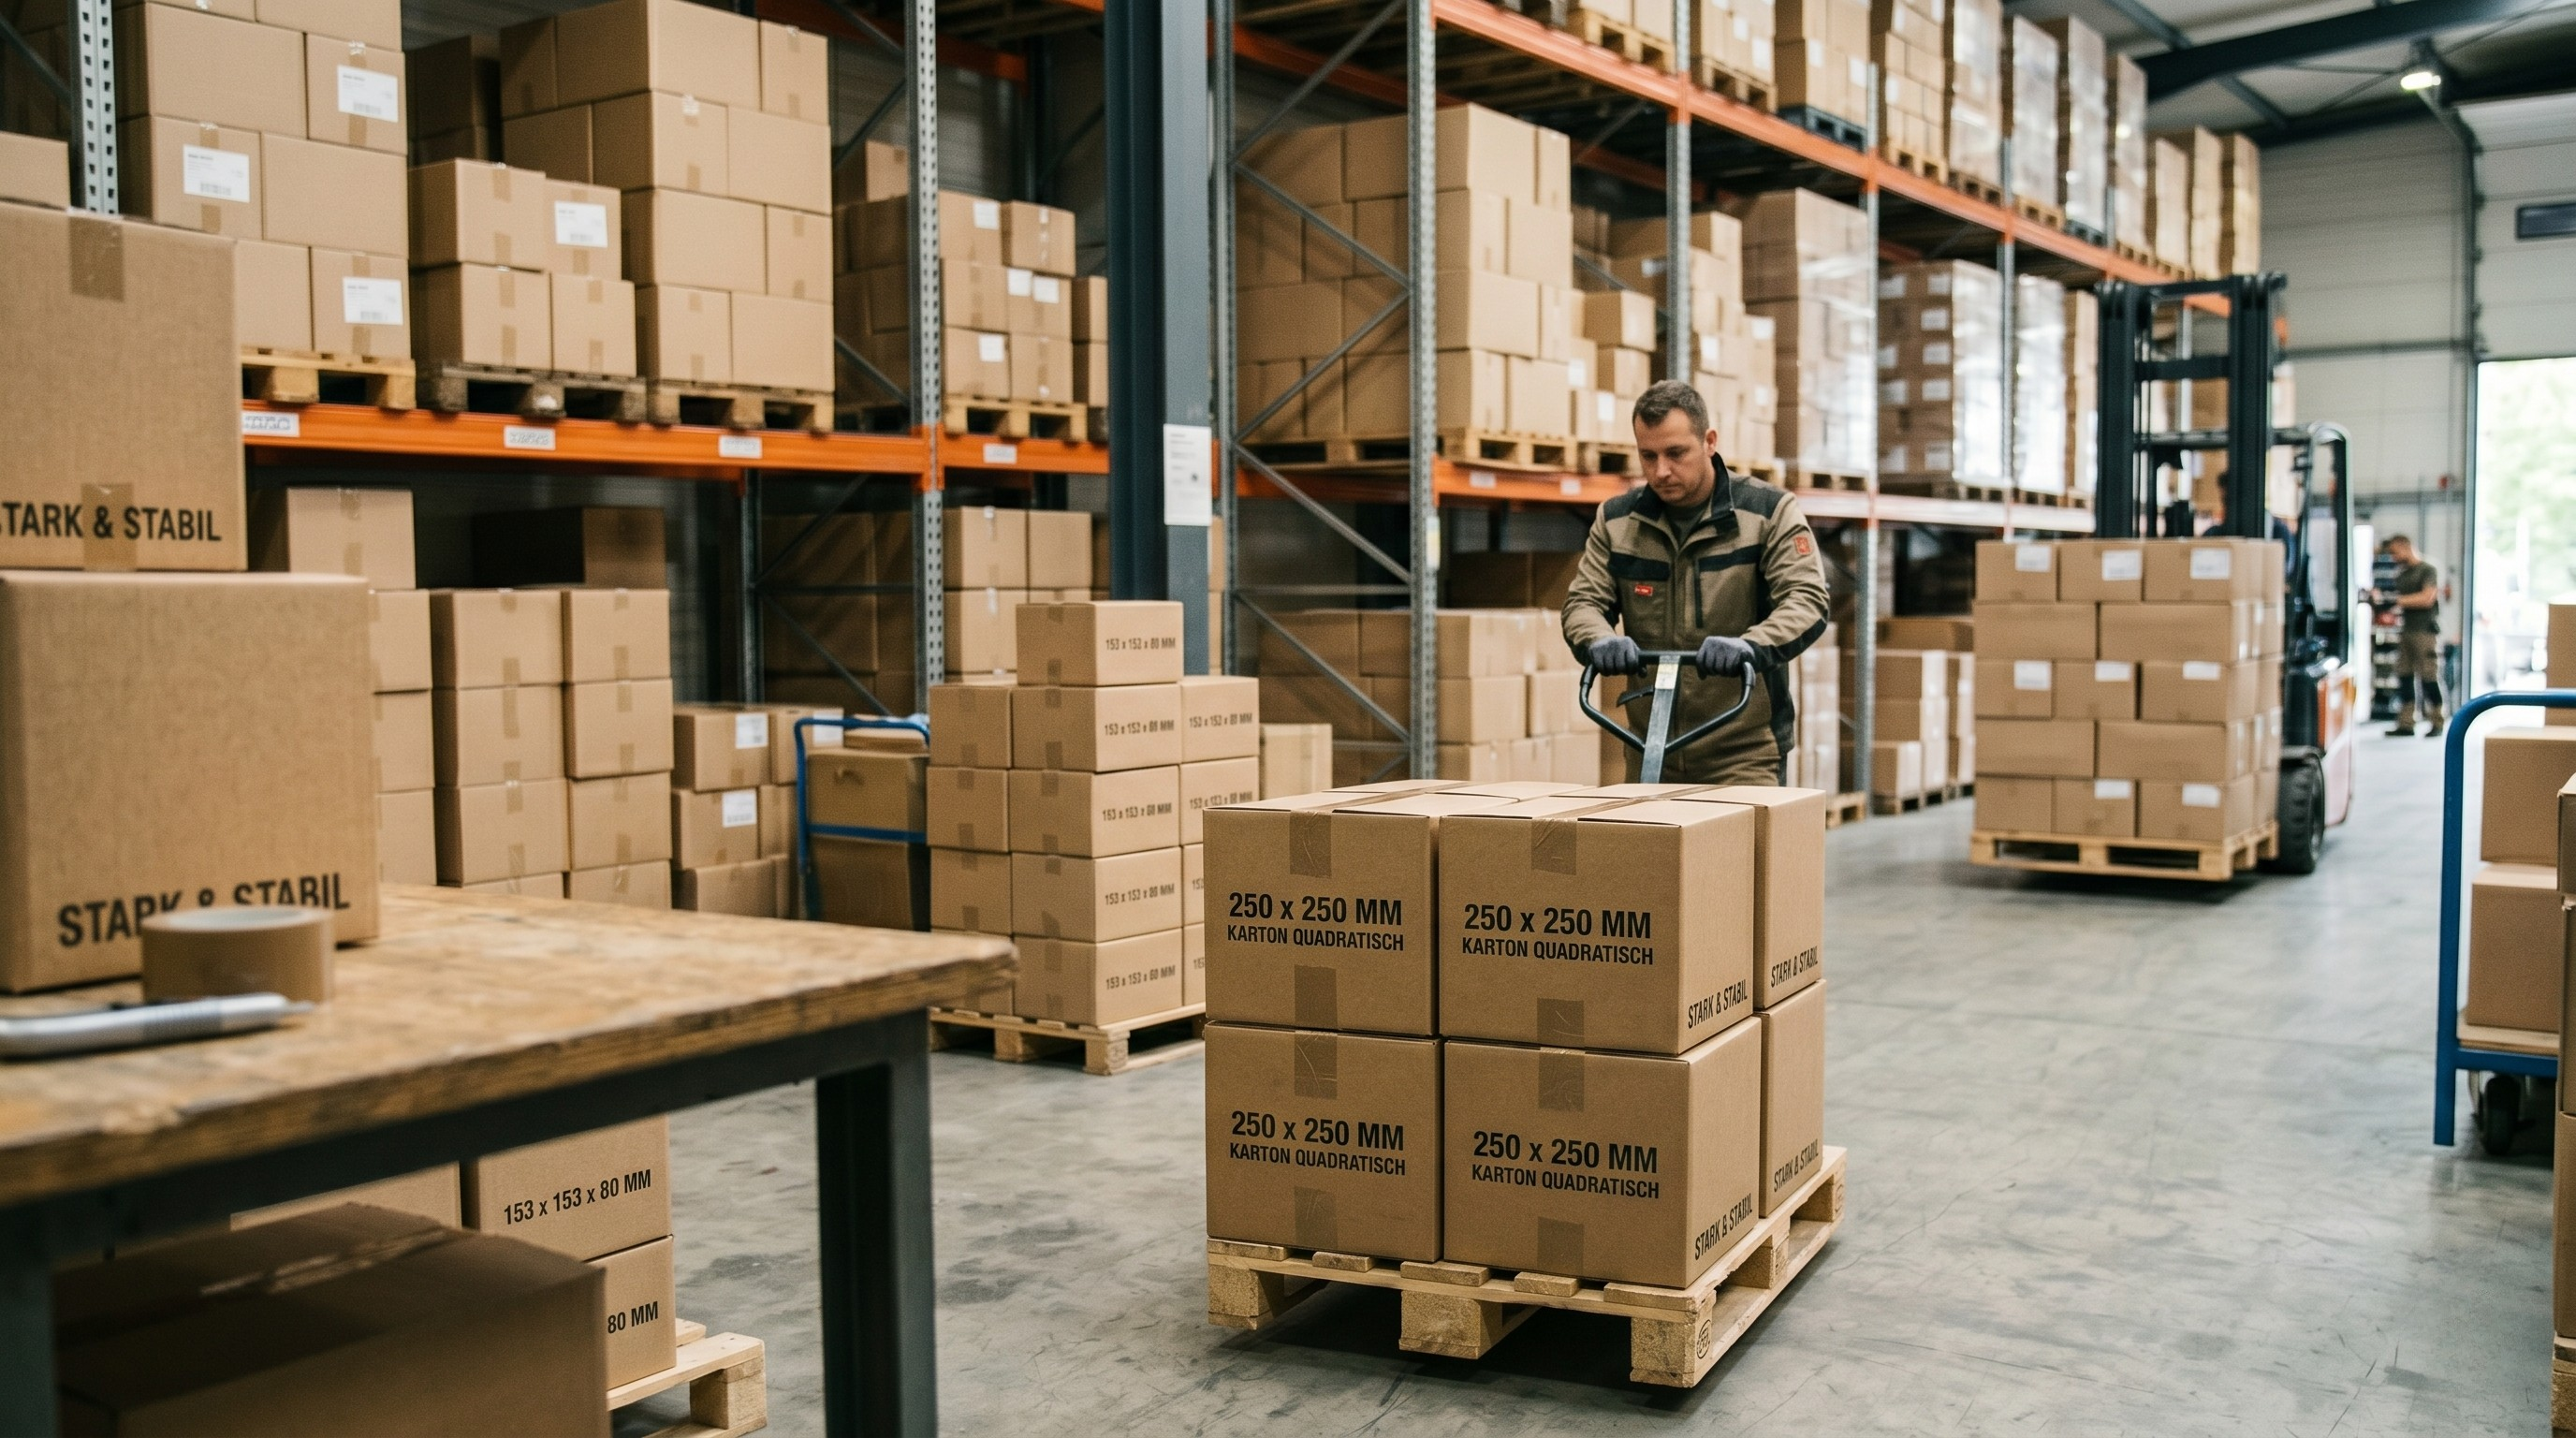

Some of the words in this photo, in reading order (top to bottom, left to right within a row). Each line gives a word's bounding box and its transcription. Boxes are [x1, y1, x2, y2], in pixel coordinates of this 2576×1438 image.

[0, 502, 83, 537] TARK
[94, 505, 113, 539] &
[124, 506, 222, 541] STABIL
[1162, 638, 1176, 649] MM
[1239, 713, 1252, 724] MM
[1157, 802, 1172, 814] MM
[1160, 884, 1175, 896] MM
[1229, 891, 1273, 919] 250
[1280, 900, 1295, 920] x
[1301, 895, 1347, 923] 250
[1355, 898, 1402, 926] MM
[1464, 903, 1513, 932] 250
[1519, 912, 1536, 933] x
[1543, 906, 1592, 936] 250
[1602, 909, 1651, 940] MM
[1227, 924, 1288, 945] KARTON
[1293, 928, 1404, 952] QUADRATISCH
[1462, 936, 1529, 958] KARTON
[1533, 940, 1654, 966] QUADRATISCH
[1105, 976, 1120, 990] 153
[1161, 964, 1176, 978] MM
[1771, 959, 1792, 989] STARK
[1688, 999, 1714, 1029] STARK
[1716, 991, 1721, 1015] &
[1723, 979, 1748, 1011] STABIL
[1231, 1109, 1276, 1139] 250
[1282, 1121, 1297, 1141] x
[1304, 1117, 1350, 1147] 250
[1357, 1121, 1404, 1152] MM
[1229, 1141, 1291, 1165] KARTON
[1295, 1148, 1406, 1176] QUADRATISCH
[1473, 1130, 1521, 1161] 250
[1528, 1142, 1544, 1163] x
[1550, 1137, 1600, 1168] 250
[1608, 1142, 1658, 1174] MM
[504, 1200, 534, 1225] 153
[538, 1200, 549, 1217] x
[553, 1187, 582, 1212] 153
[586, 1188, 595, 1204] x
[600, 1177, 620, 1200] 80
[623, 1168, 651, 1194] MM
[1471, 1163, 1537, 1187] KARTON
[1541, 1170, 1660, 1200] QUADRATISCH
[1694, 1216, 1720, 1261] STARK
[607, 1312, 626, 1334] 80
[631, 1300, 659, 1328] MM
